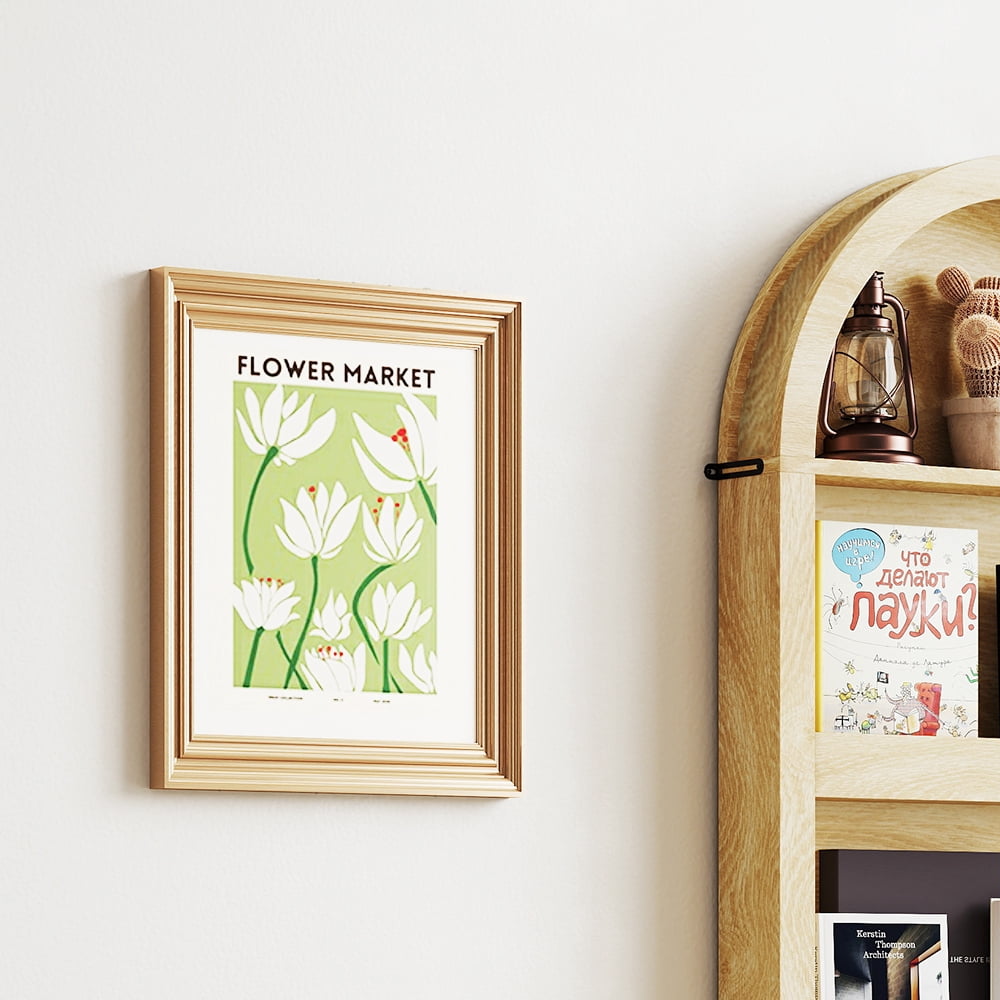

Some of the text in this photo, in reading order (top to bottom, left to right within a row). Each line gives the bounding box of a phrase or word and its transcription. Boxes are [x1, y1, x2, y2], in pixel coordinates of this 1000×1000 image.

[238, 355, 436, 389] FLOWER MARKET
[856, 929, 887, 938] Kerstin
[874, 939, 916, 951] Thompson
[863, 950, 905, 959] Architects
